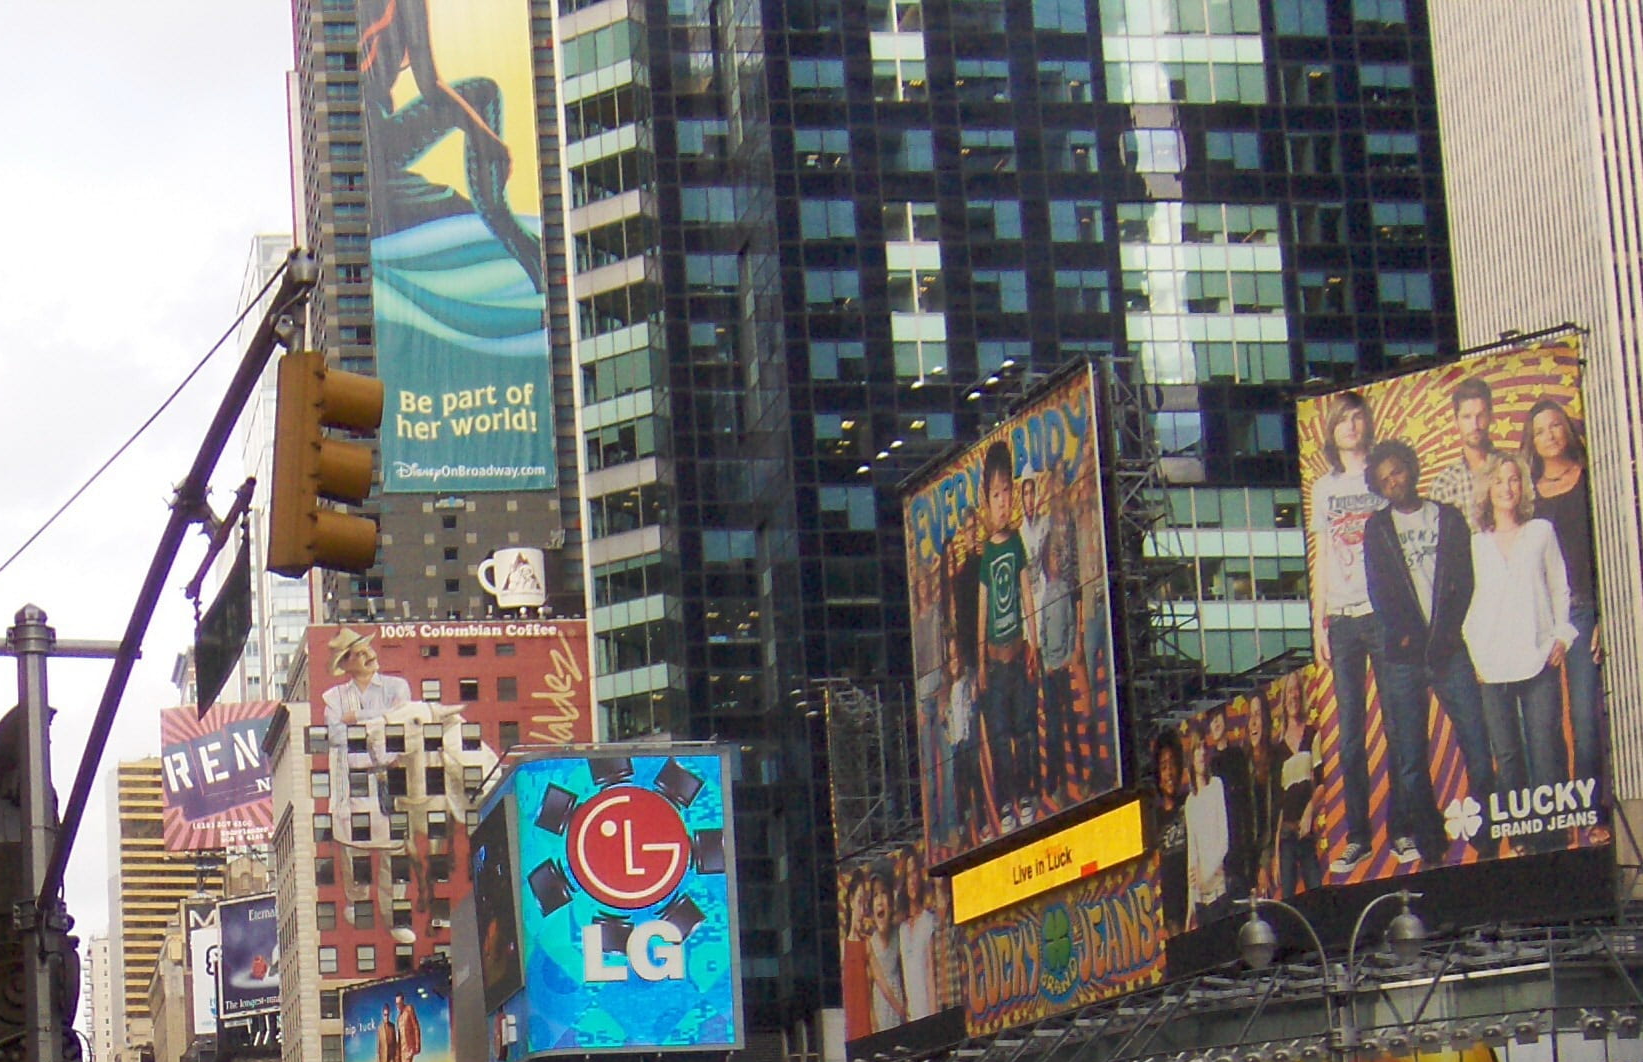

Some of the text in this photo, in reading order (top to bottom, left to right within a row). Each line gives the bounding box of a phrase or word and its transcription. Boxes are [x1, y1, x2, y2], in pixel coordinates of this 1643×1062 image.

[399, 382, 535, 417] Be part of
[396, 407, 539, 441] her world!
[1009, 390, 1092, 488] BODY
[393, 459, 547, 483] DisneyOnBroadway.com
[908, 456, 985, 566] EVERY
[1398, 529, 1438, 545] UCKY
[379, 622, 558, 638] 100% Colombian Coffee
[163, 728, 262, 794] REN
[1489, 777, 1596, 823] LUCKY
[1490, 810, 1599, 841] BRAND JEANS
[1012, 846, 1074, 886] Live in Luck
[582, 919, 685, 983] LG
[963, 879, 1156, 1014] LUCKY JEANS
